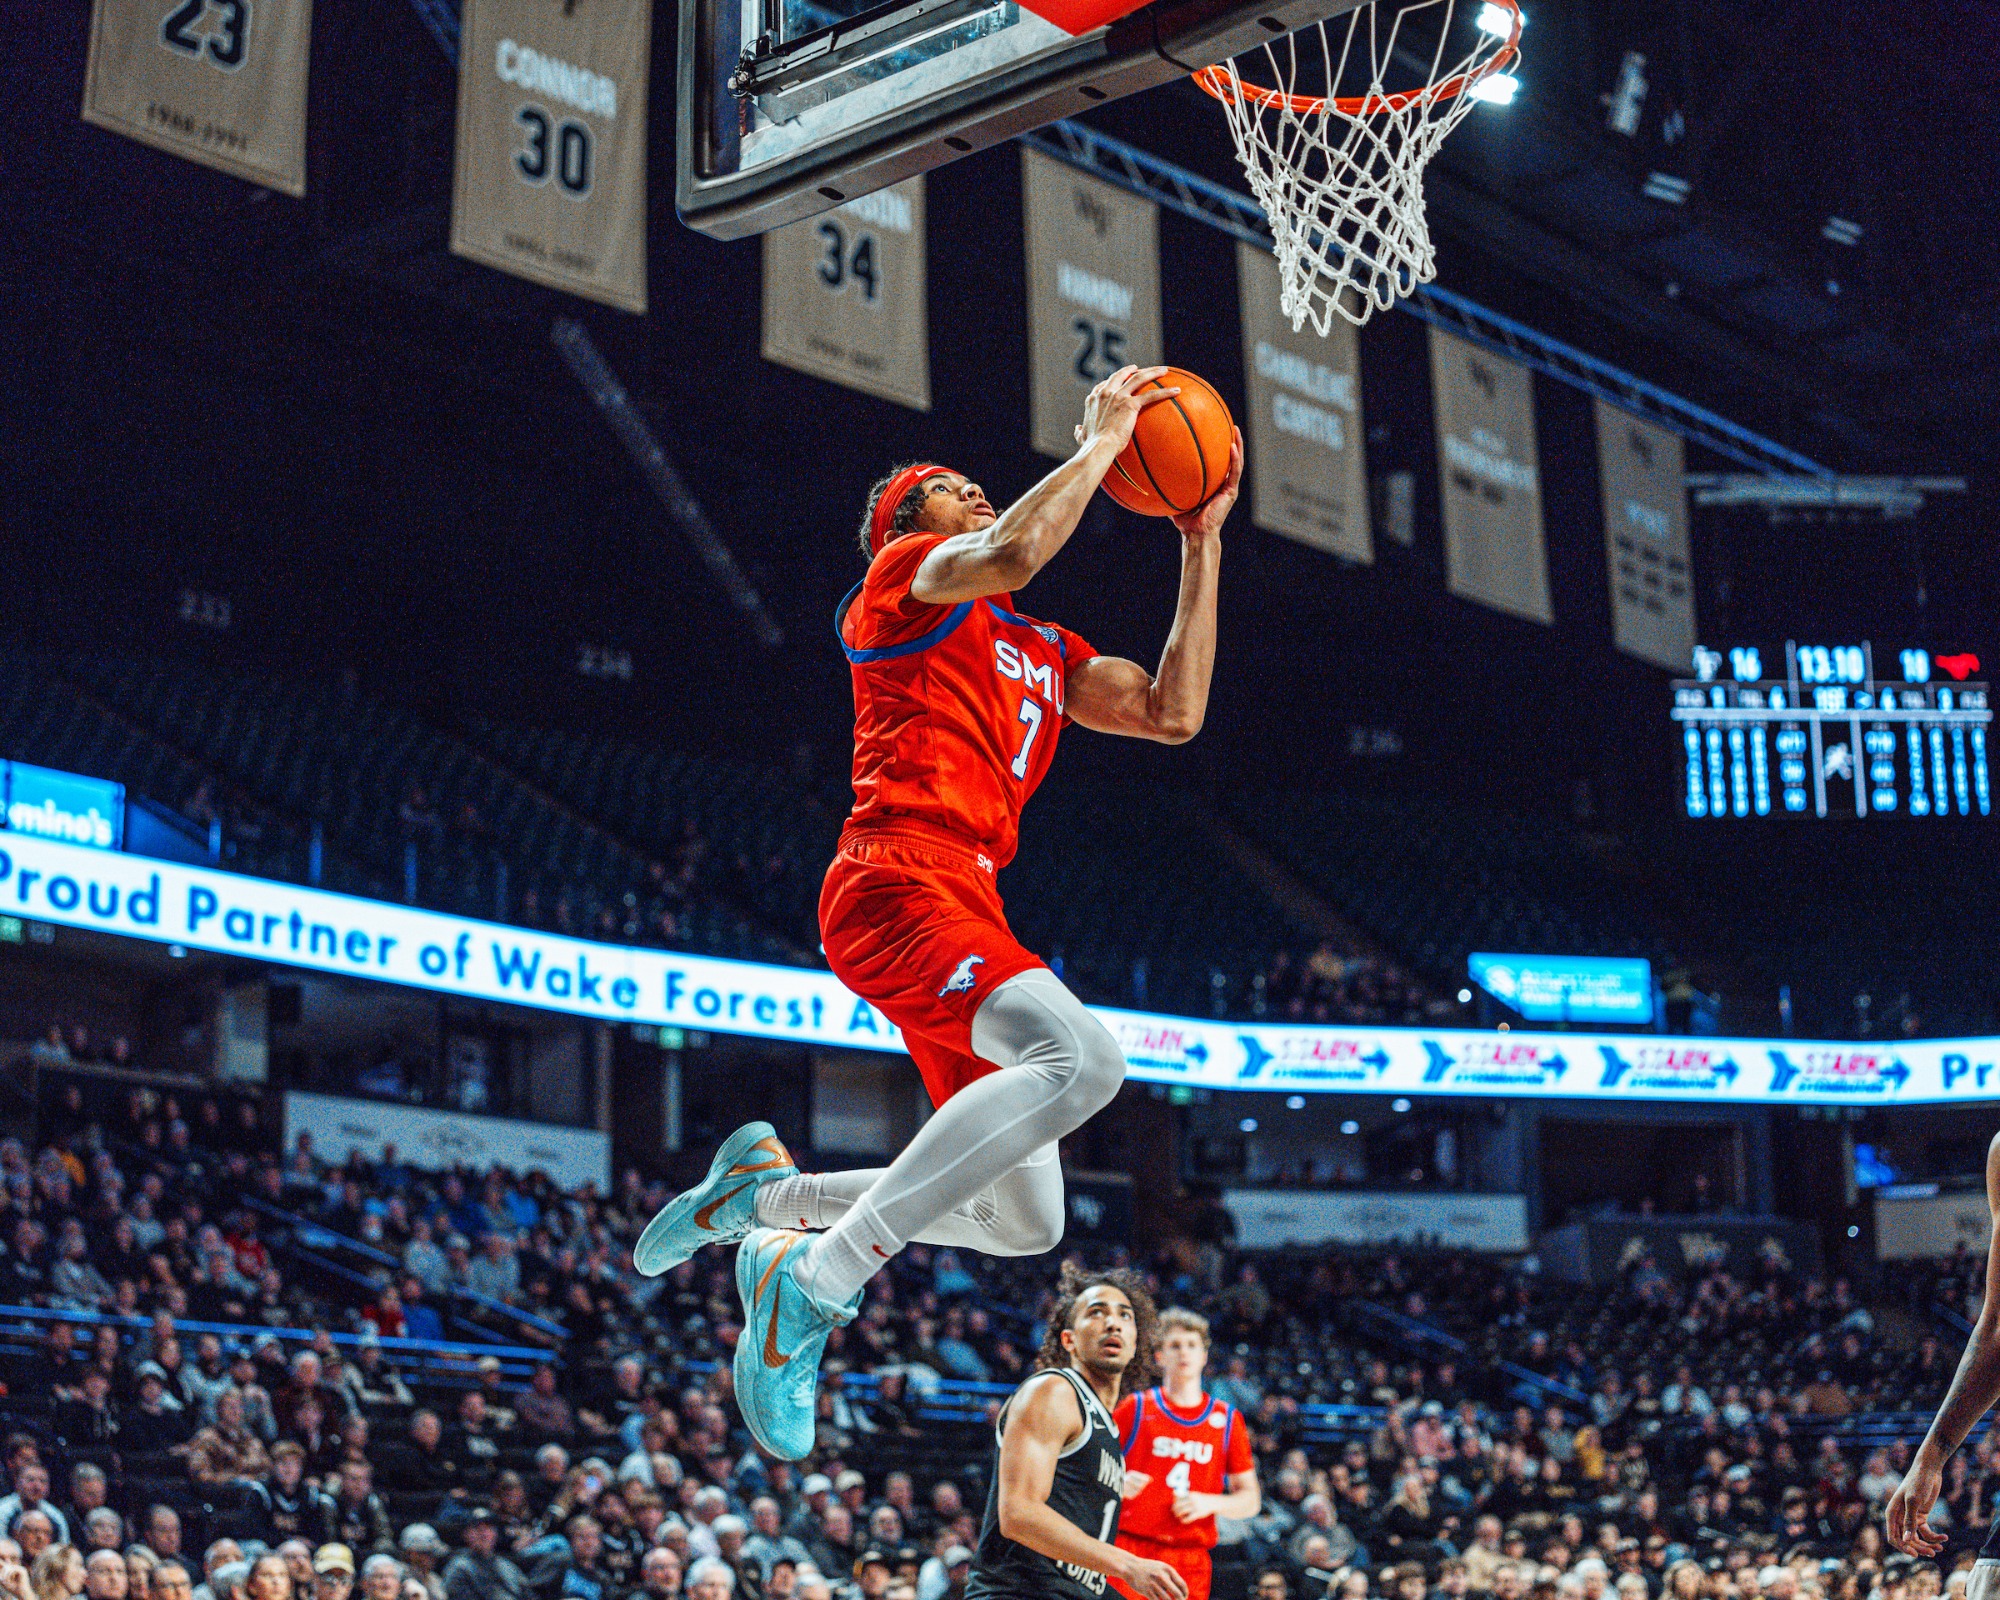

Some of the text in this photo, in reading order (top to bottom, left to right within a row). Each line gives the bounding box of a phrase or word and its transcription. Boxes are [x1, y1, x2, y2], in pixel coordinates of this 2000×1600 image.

[514, 104, 594, 197] 30
[815, 217, 878, 303] 34
[1072, 317, 1127, 383] 25
[994, 638, 1065, 716] SMU
[1729, 646, 1763, 683] 16
[1011, 696, 1043, 781] 7
[187, 885, 398, 966] Partner
[419, 931, 472, 978] of
[492, 942, 639, 1009] Wake
[665, 970, 824, 1029] Forest
[1151, 1435, 1214, 1465] SMU
[1165, 1461, 1191, 1498] 4
